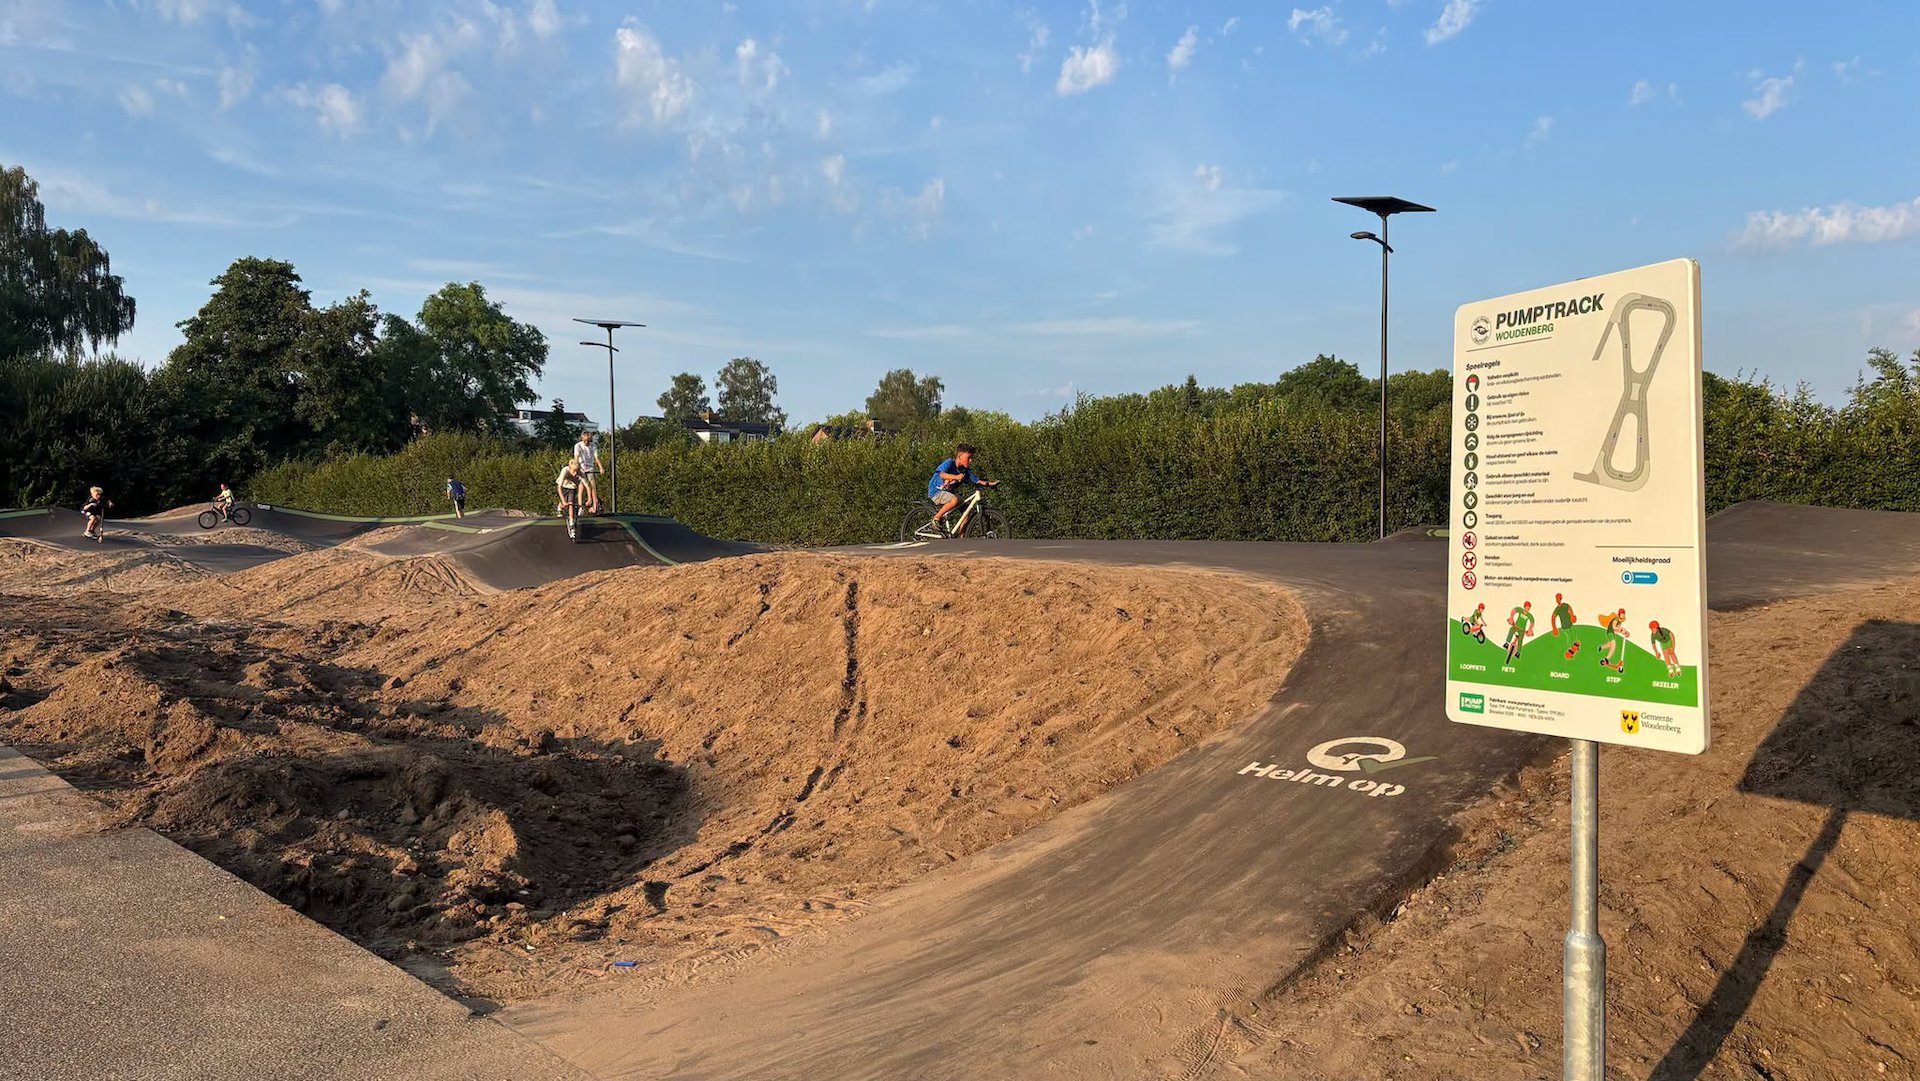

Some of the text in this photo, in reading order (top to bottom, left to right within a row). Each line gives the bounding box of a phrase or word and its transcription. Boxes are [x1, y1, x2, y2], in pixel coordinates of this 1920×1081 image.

[1495, 293, 1605, 330] PUMPTRACK
[1495, 323, 1554, 341] WOUDENBERG
[1466, 360, 1500, 371] Speelregels
[1460, 663, 1486, 671] LOOPFIETS
[1550, 671, 1570, 679] BOARD
[1652, 680, 1679, 689] SKEELER
[1640, 711, 1673, 723] Gemeente
[1640, 720, 1682, 734] Woudenberg
[1237, 761, 1406, 797] Helm op
